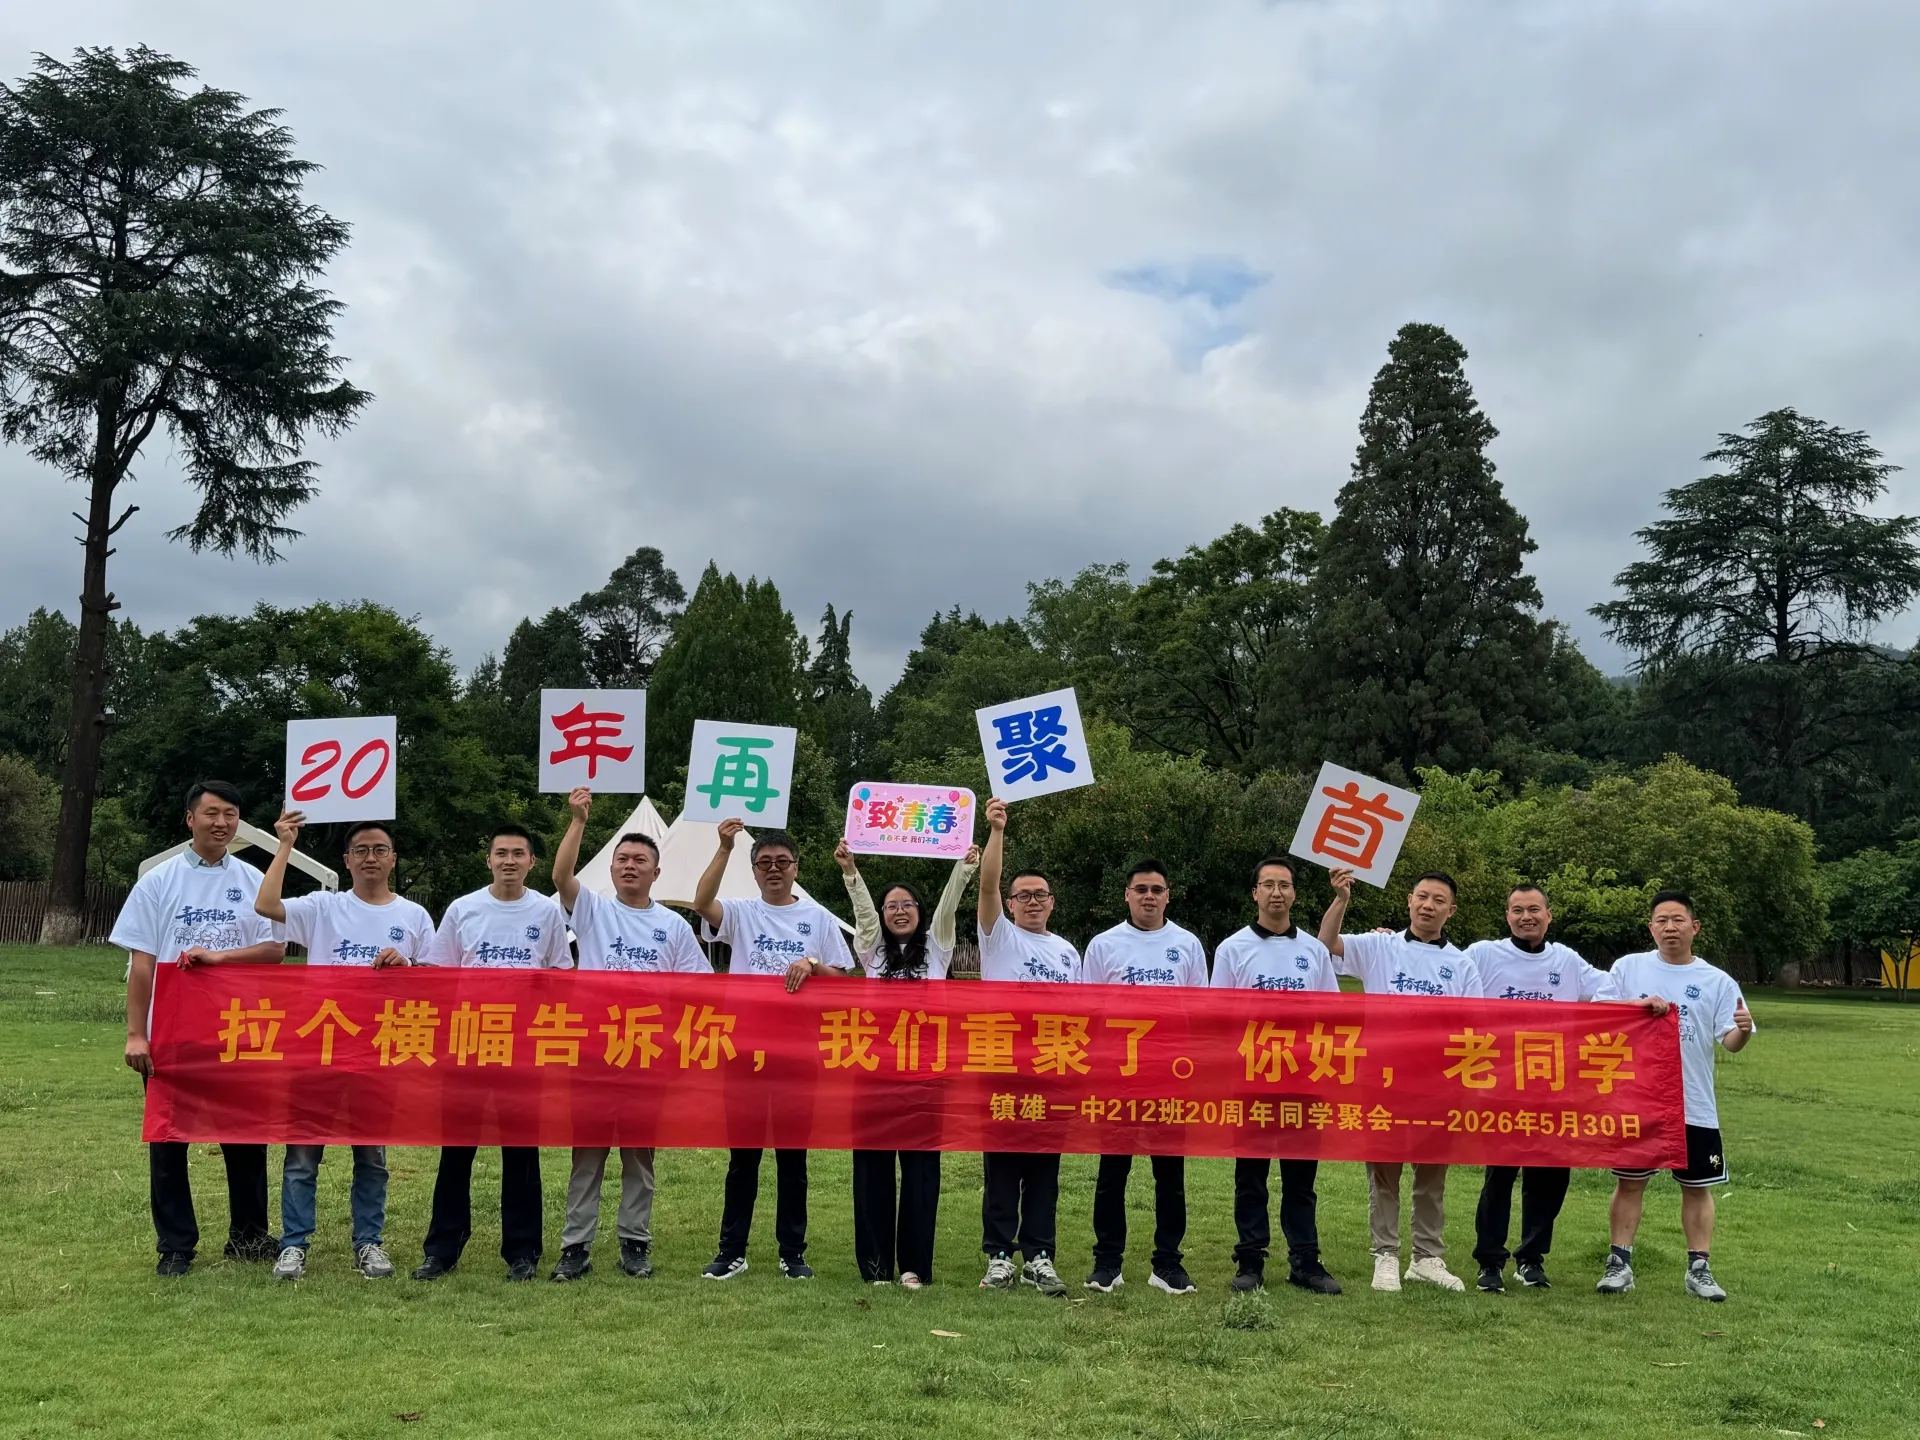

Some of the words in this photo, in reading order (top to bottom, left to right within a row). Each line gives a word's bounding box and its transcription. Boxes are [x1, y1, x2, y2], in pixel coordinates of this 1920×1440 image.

[293, 739, 389, 802] 20
[550, 703, 633, 779] 年
[697, 737, 780, 813] 再
[991, 705, 1076, 785] 聚
[865, 800, 958, 834] 致青春
[1311, 780, 1405, 870] 首
[218, 997, 1636, 1095] 拉个横幅告诉你，我们重聚了。你好，老同学
[990, 1092, 1641, 1138] 镇雄一中212班20周年同学聚会---2026年5月30日
